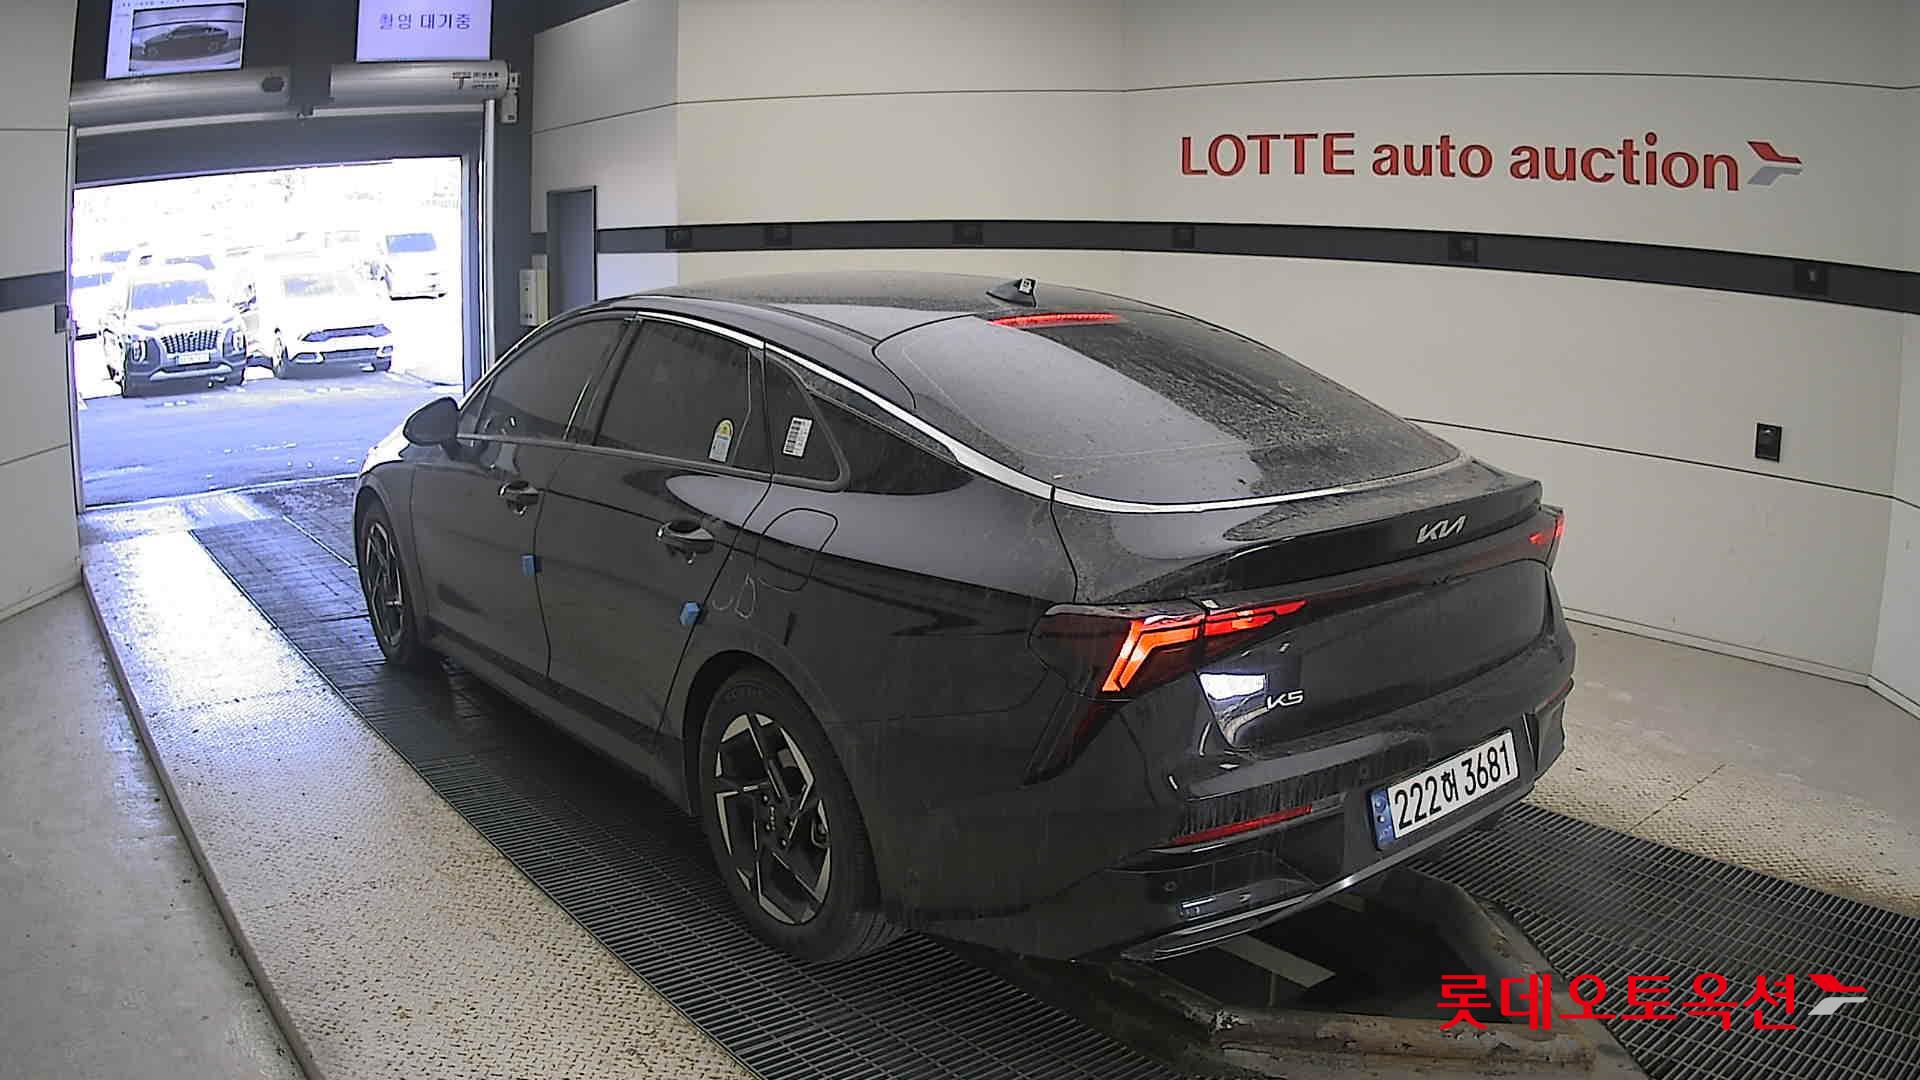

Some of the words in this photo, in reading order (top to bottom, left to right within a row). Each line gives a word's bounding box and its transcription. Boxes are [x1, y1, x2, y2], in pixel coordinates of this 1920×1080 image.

[420, 13, 471, 30] 대기중
[1181, 132, 1355, 176] LOTTE
[1371, 134, 1493, 178] auto
[1509, 131, 1739, 191] auction
[1266, 689, 1304, 709] K5
[1394, 767, 1460, 830] 222허
[1461, 740, 1511, 796] 3681
